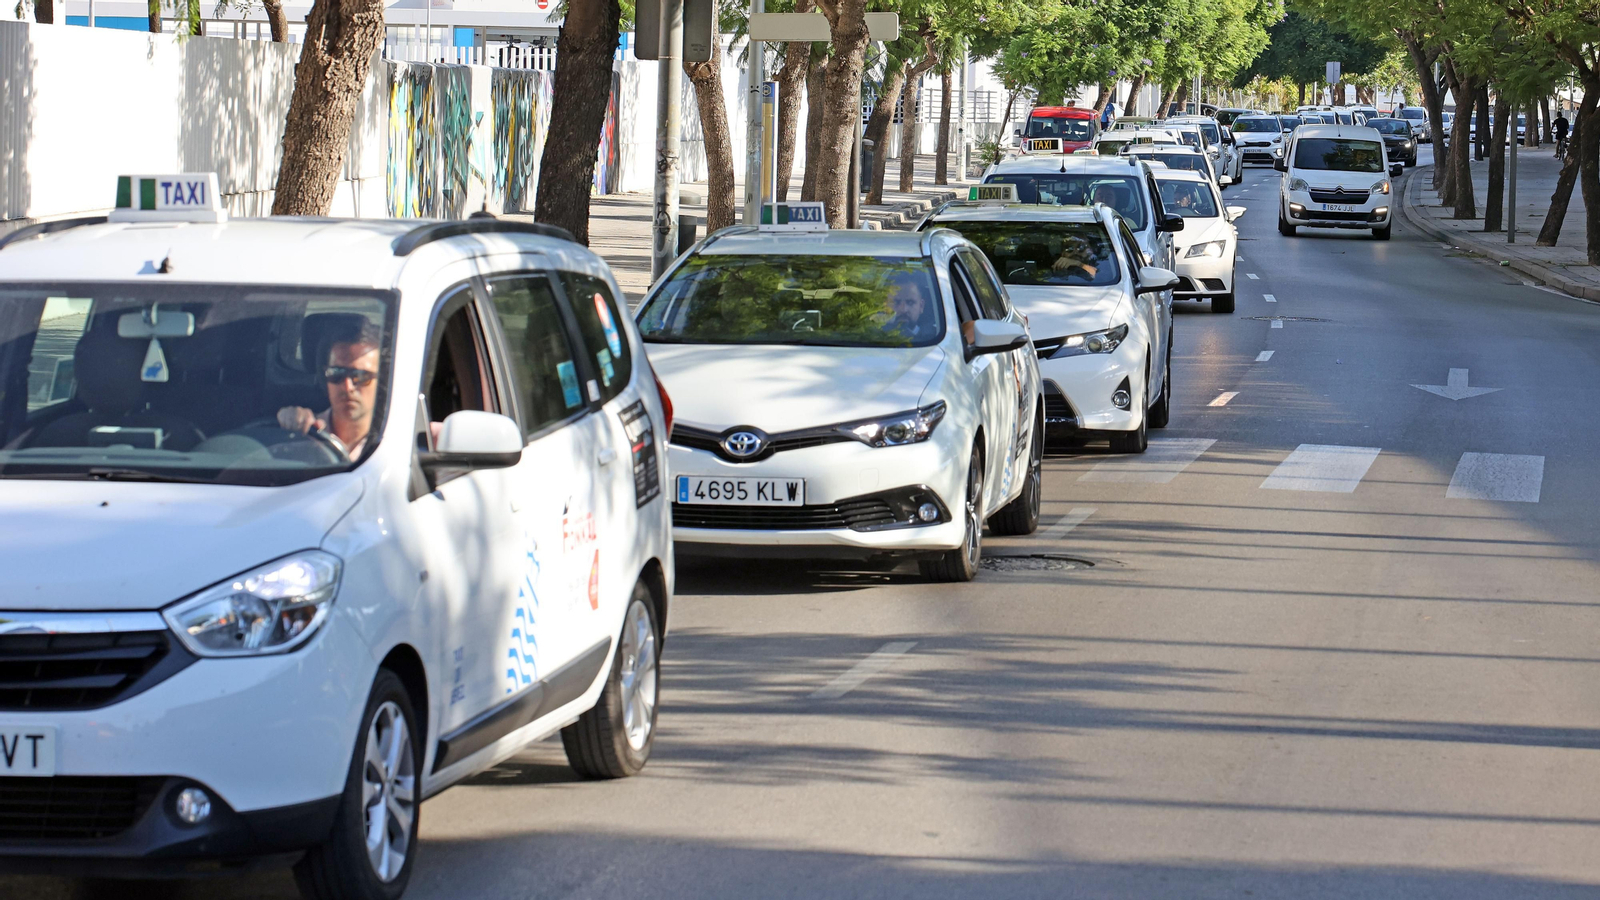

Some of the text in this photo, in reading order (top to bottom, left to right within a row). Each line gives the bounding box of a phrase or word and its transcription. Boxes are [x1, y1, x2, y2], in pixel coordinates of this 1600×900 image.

[1034, 140, 1052, 150] TAXI
[161, 182, 205, 205] TAXI
[980, 187, 1001, 199] TAXI
[791, 208, 819, 220] TAXI
[694, 480, 798, 502] 4695 KLW
